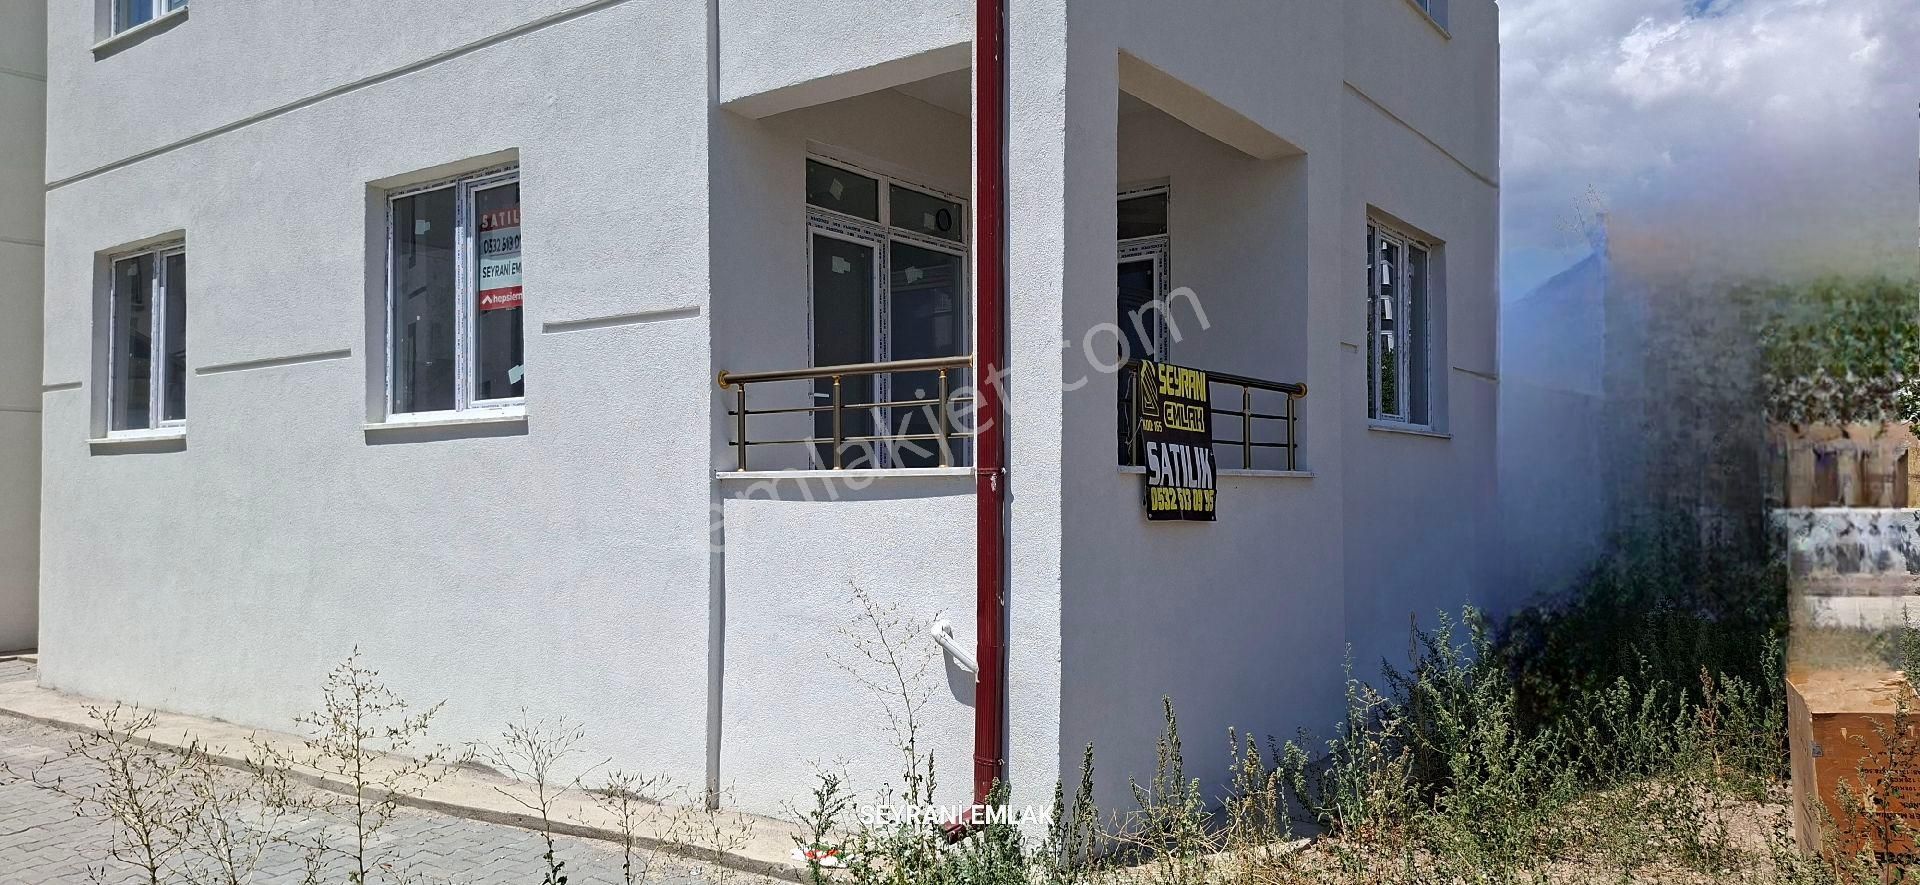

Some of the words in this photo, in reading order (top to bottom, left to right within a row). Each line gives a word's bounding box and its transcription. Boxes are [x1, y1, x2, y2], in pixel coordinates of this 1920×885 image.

[483, 238, 501, 253] 0532
[502, 236, 514, 251] 513
[515, 234, 522, 249] 0
[1158, 363, 1206, 402] SEYRANI
[1164, 401, 1205, 432] EMLAK
[1146, 441, 1213, 489] SATILIK
[1151, 487, 1178, 511] 0532
[1176, 488, 1192, 511] 513
